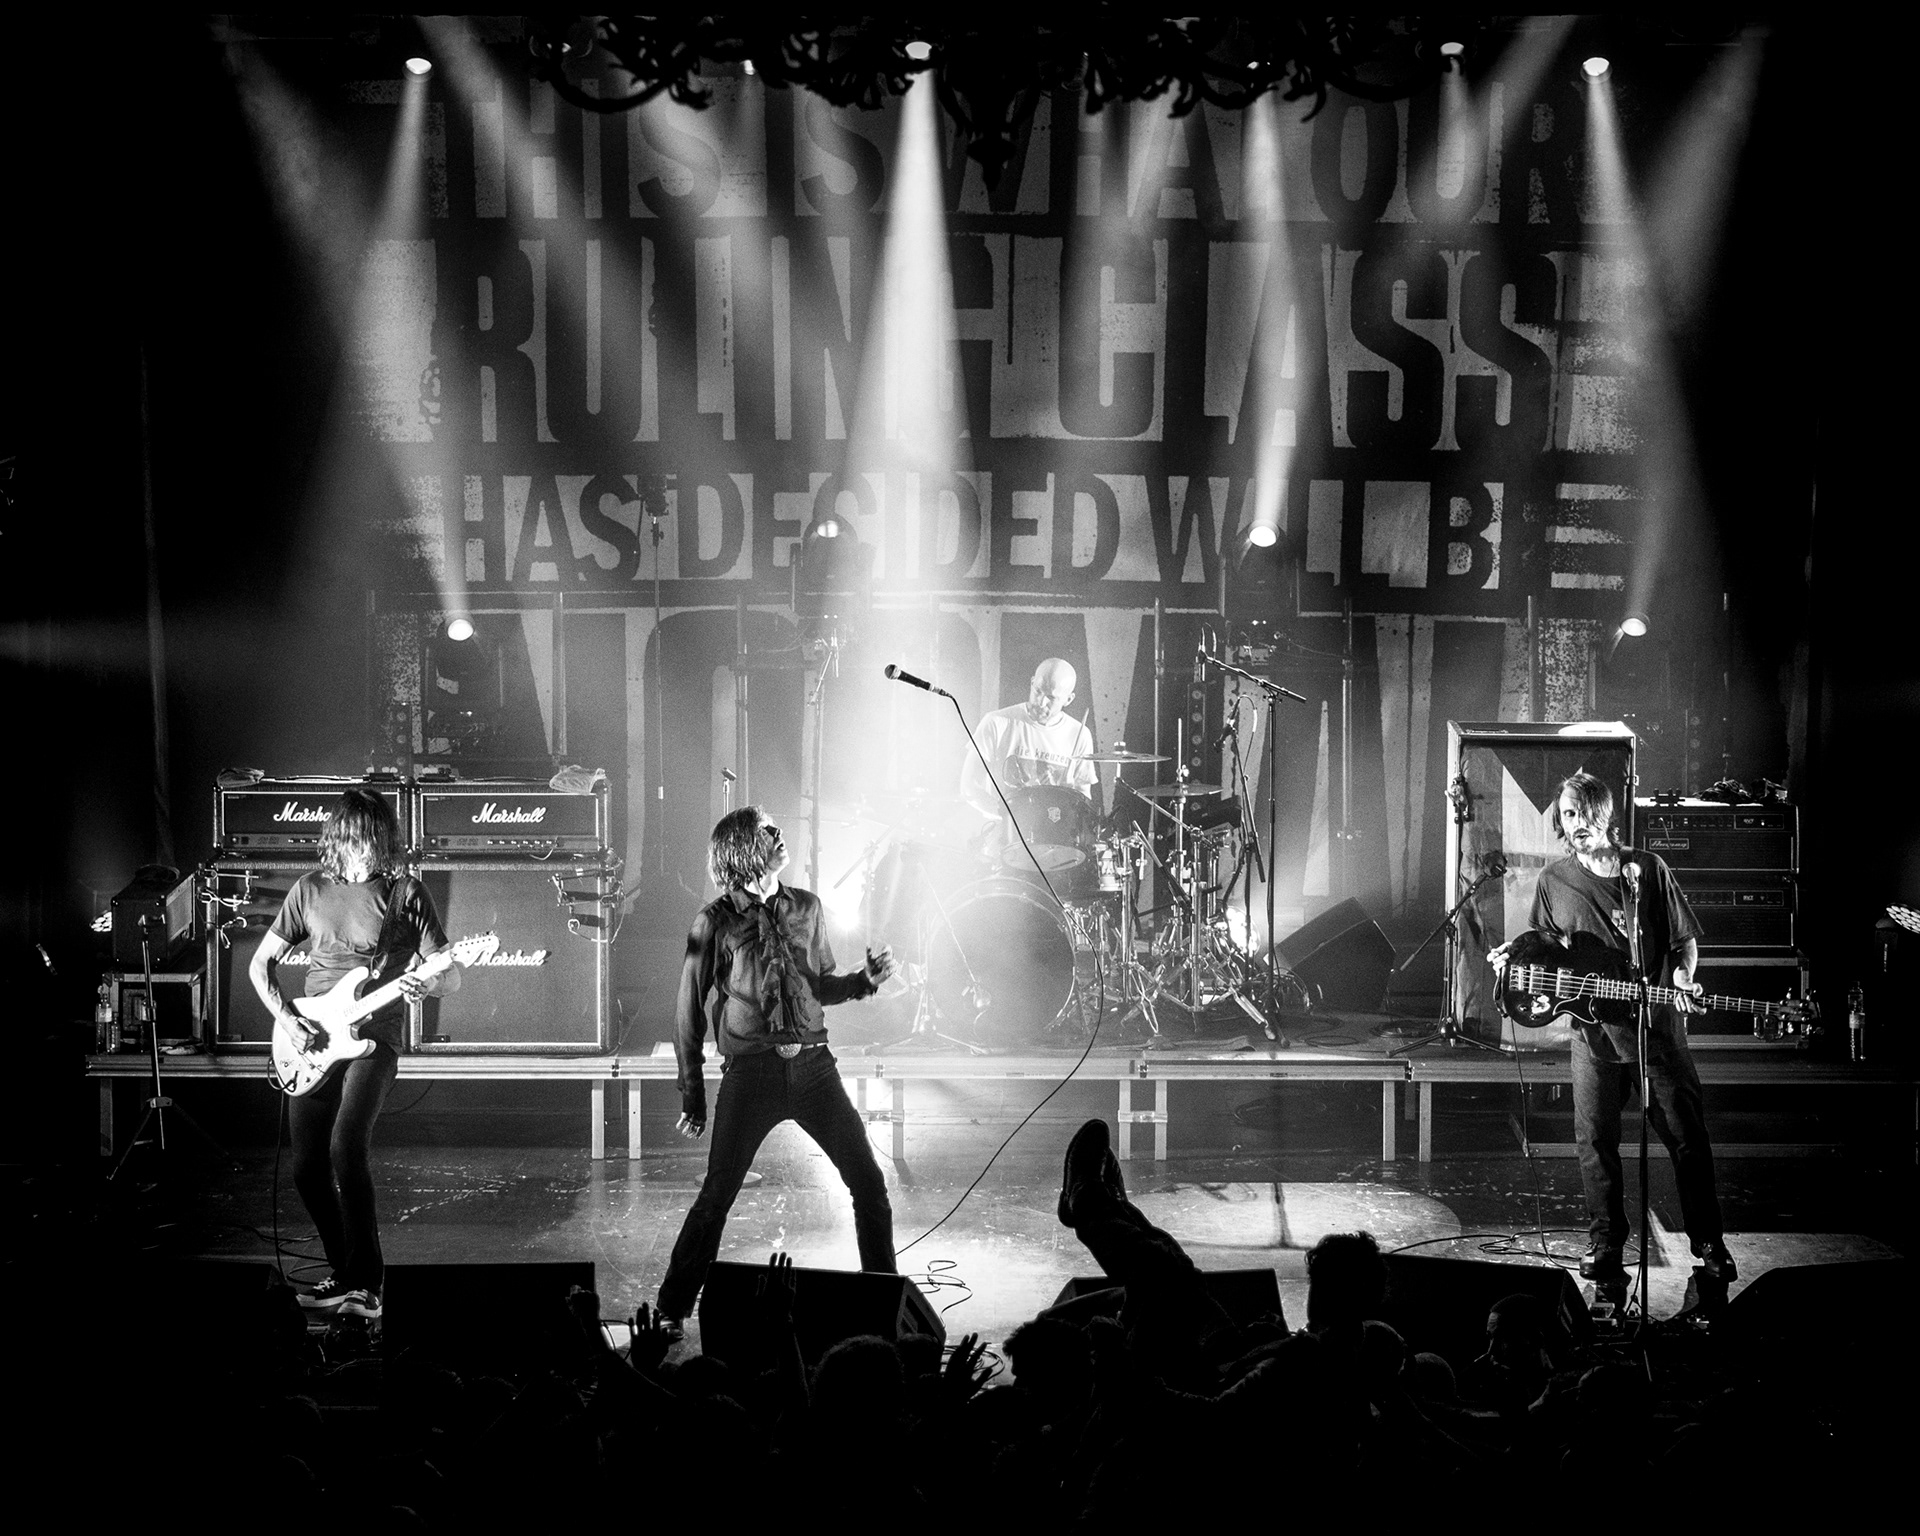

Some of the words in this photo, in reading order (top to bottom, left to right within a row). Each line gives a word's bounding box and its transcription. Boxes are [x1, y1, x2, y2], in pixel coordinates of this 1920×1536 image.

[1311, 80, 1582, 224] OUR
[1057, 236, 1560, 453] CLASS
[443, 472, 642, 584] HAS
[1143, 474, 1392, 590] WLL
[273, 801, 332, 822] Marsha
[471, 802, 547, 823] Marshall
[474, 948, 547, 966] Marshall
